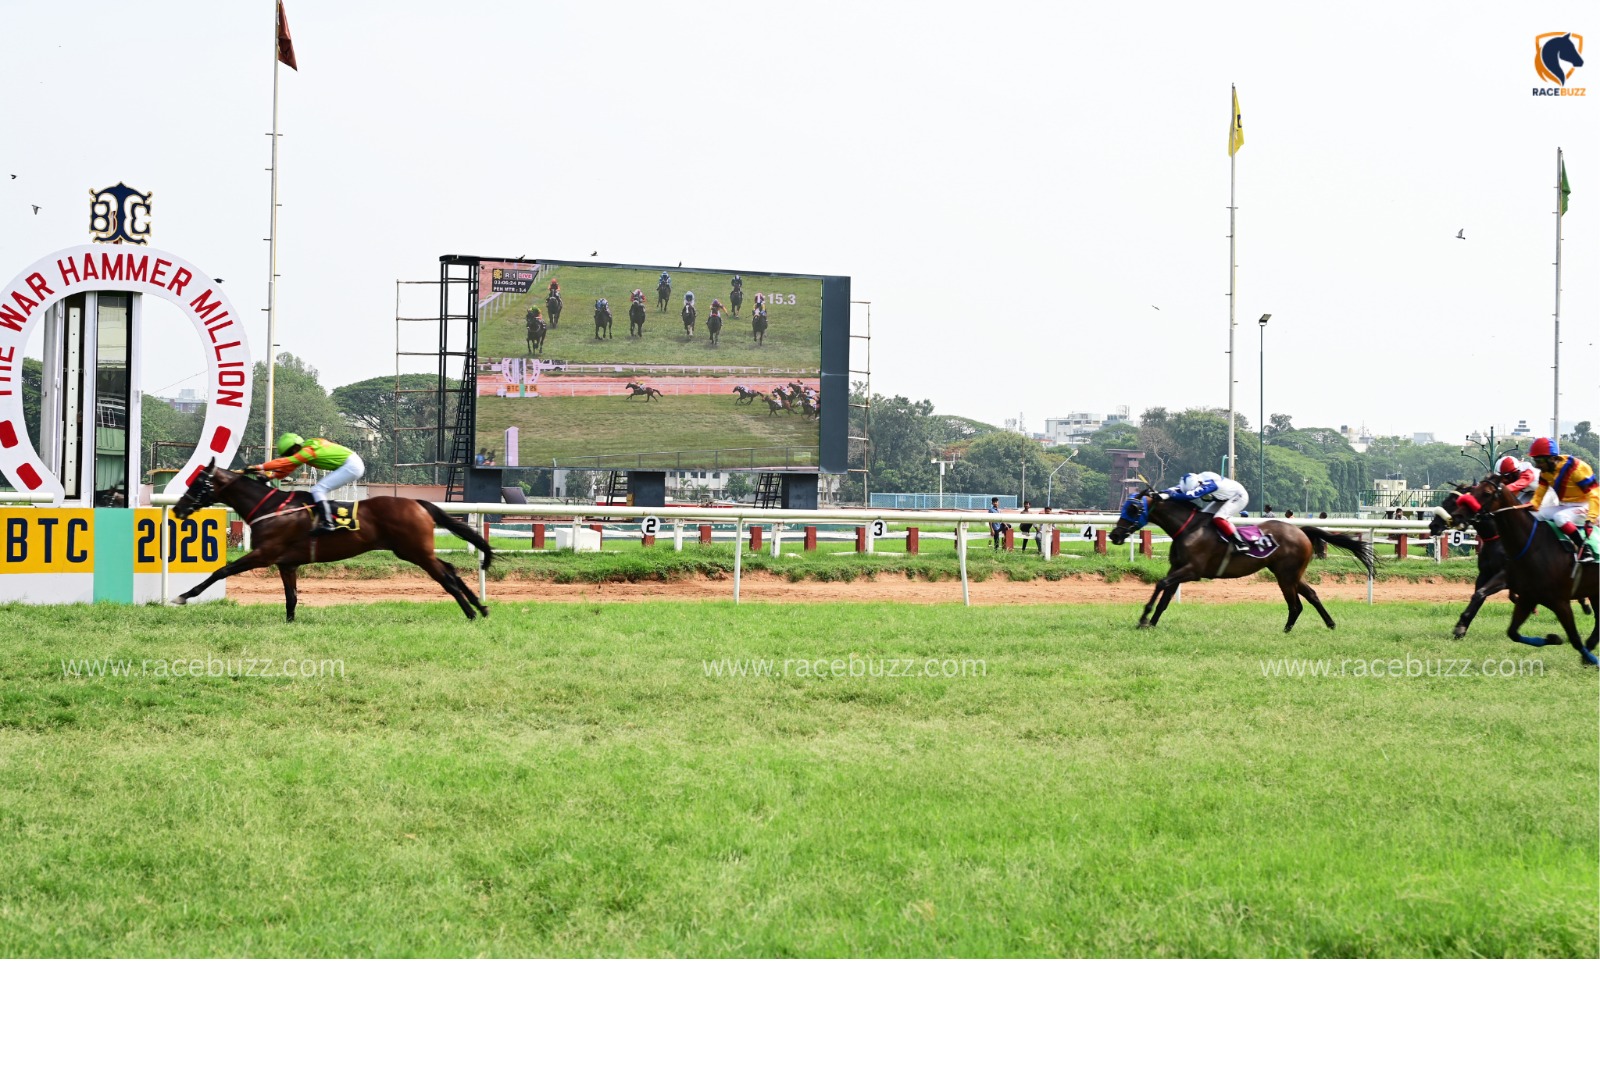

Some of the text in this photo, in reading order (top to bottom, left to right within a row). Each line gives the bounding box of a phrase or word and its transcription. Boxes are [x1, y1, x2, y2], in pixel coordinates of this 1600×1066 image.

[0, 252, 245, 408] WAR HAMMER MILLION
[646, 518, 656, 533] 2
[873, 521, 883, 536] 3
[1083, 525, 1093, 540] 4
[6, 517, 219, 564] BTC 2026
[1453, 531, 1461, 544] 6
